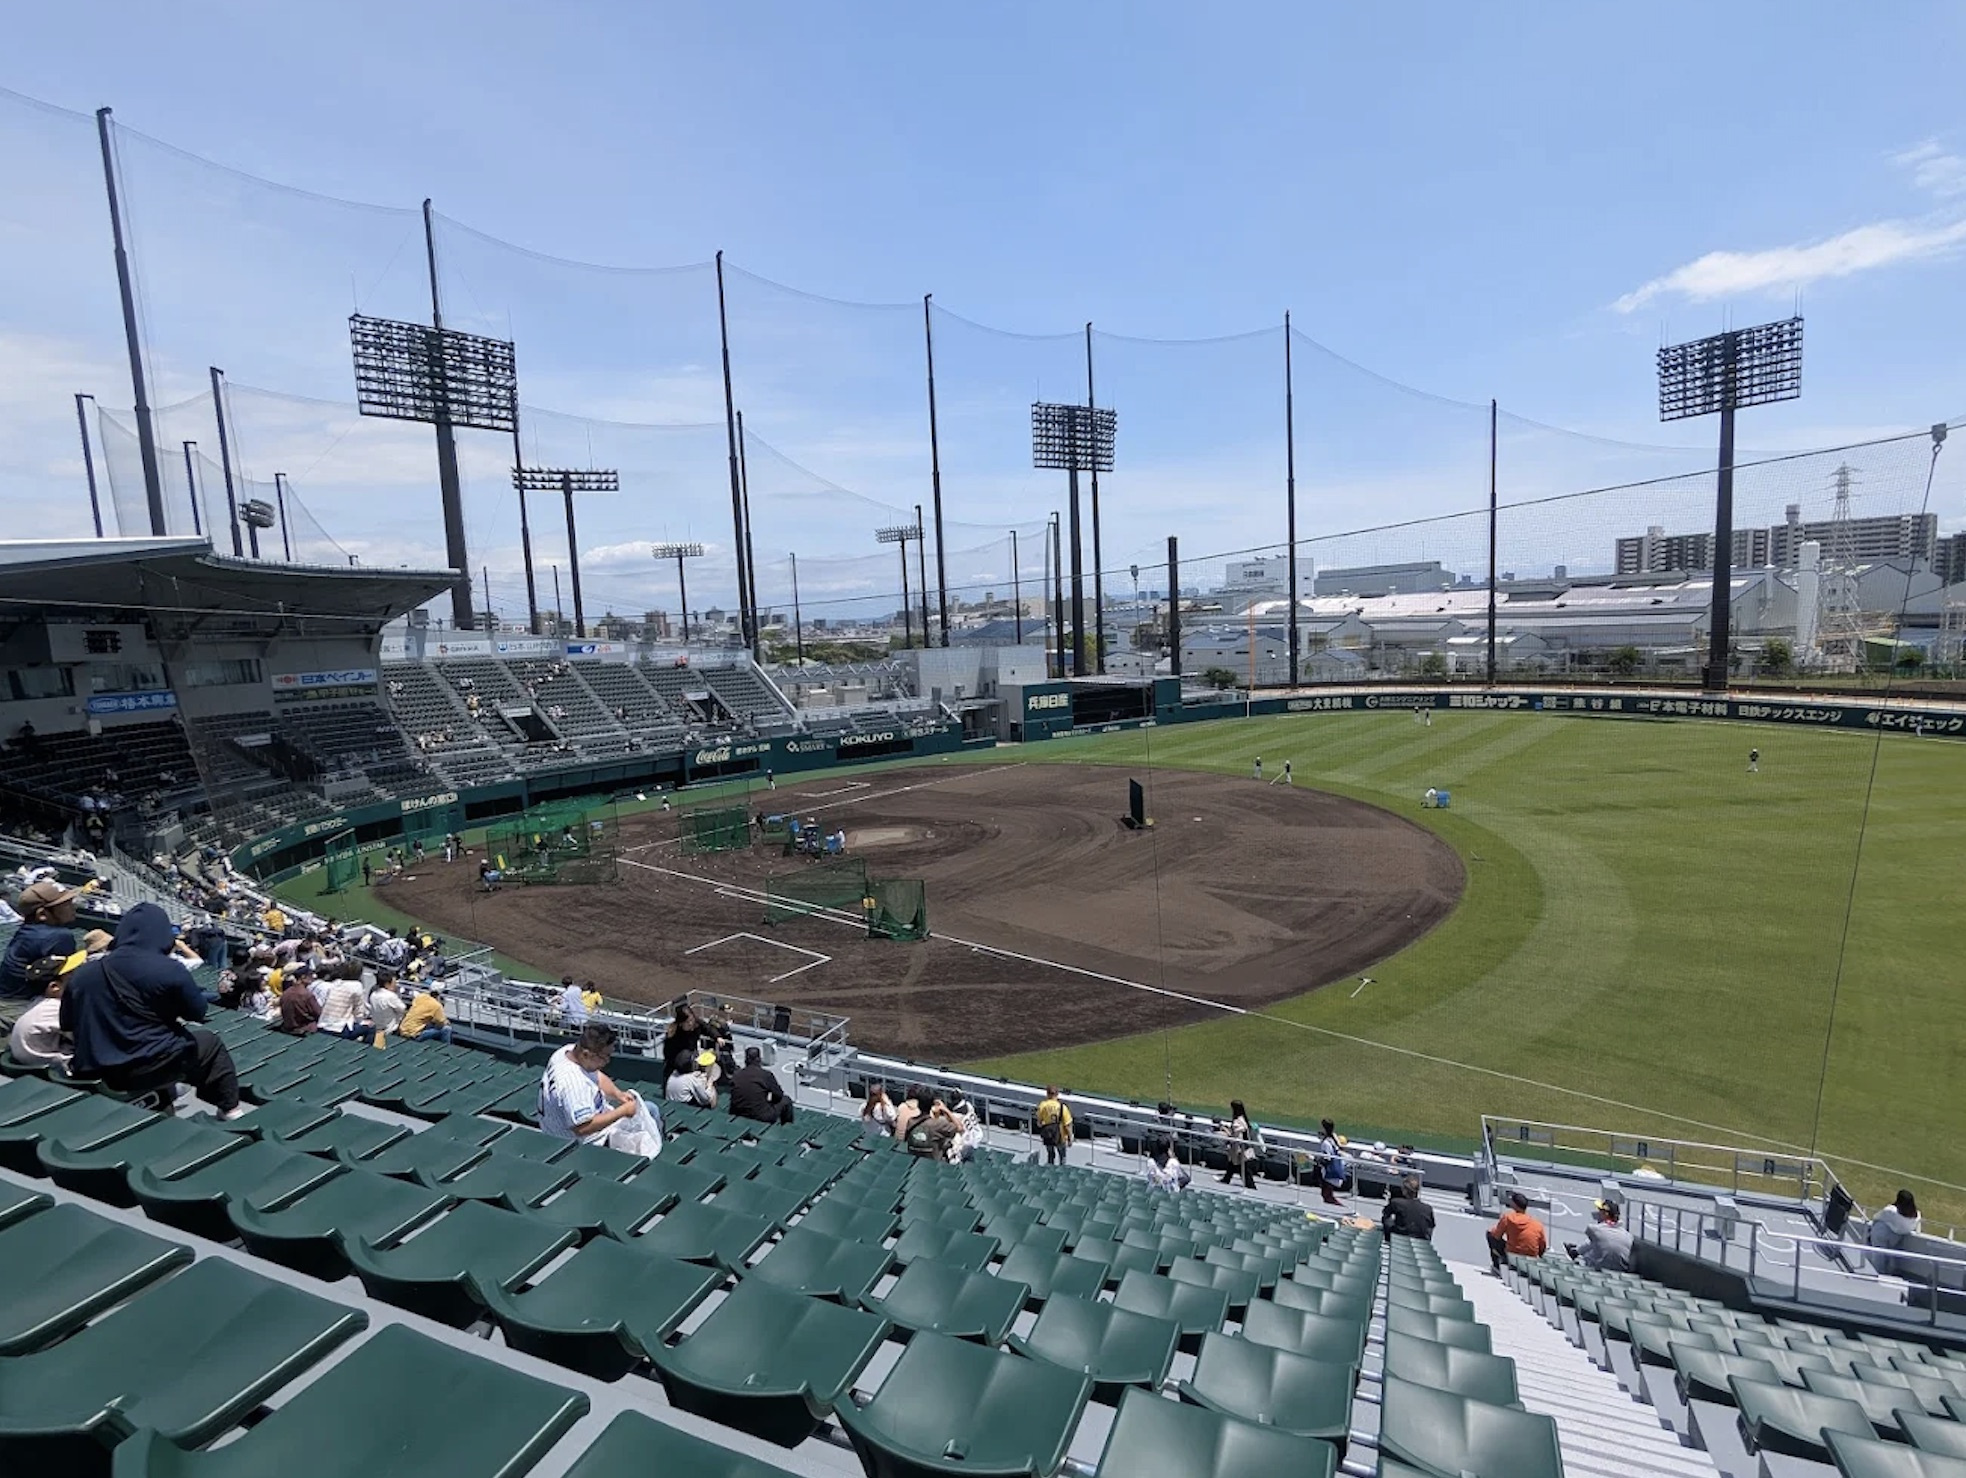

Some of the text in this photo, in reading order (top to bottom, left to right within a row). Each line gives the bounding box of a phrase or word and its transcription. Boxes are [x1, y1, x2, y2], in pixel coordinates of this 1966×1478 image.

[301, 672, 372, 684] 日本ペイント
[1028, 693, 1069, 710] 兵庫日産
[1449, 695, 1529, 708] 三和シャッター
[1738, 705, 1843, 722] 日鉄テックスエンジ
[1882, 713, 1964, 731] エイジェック
[840, 732, 894, 746] KOKUYO
